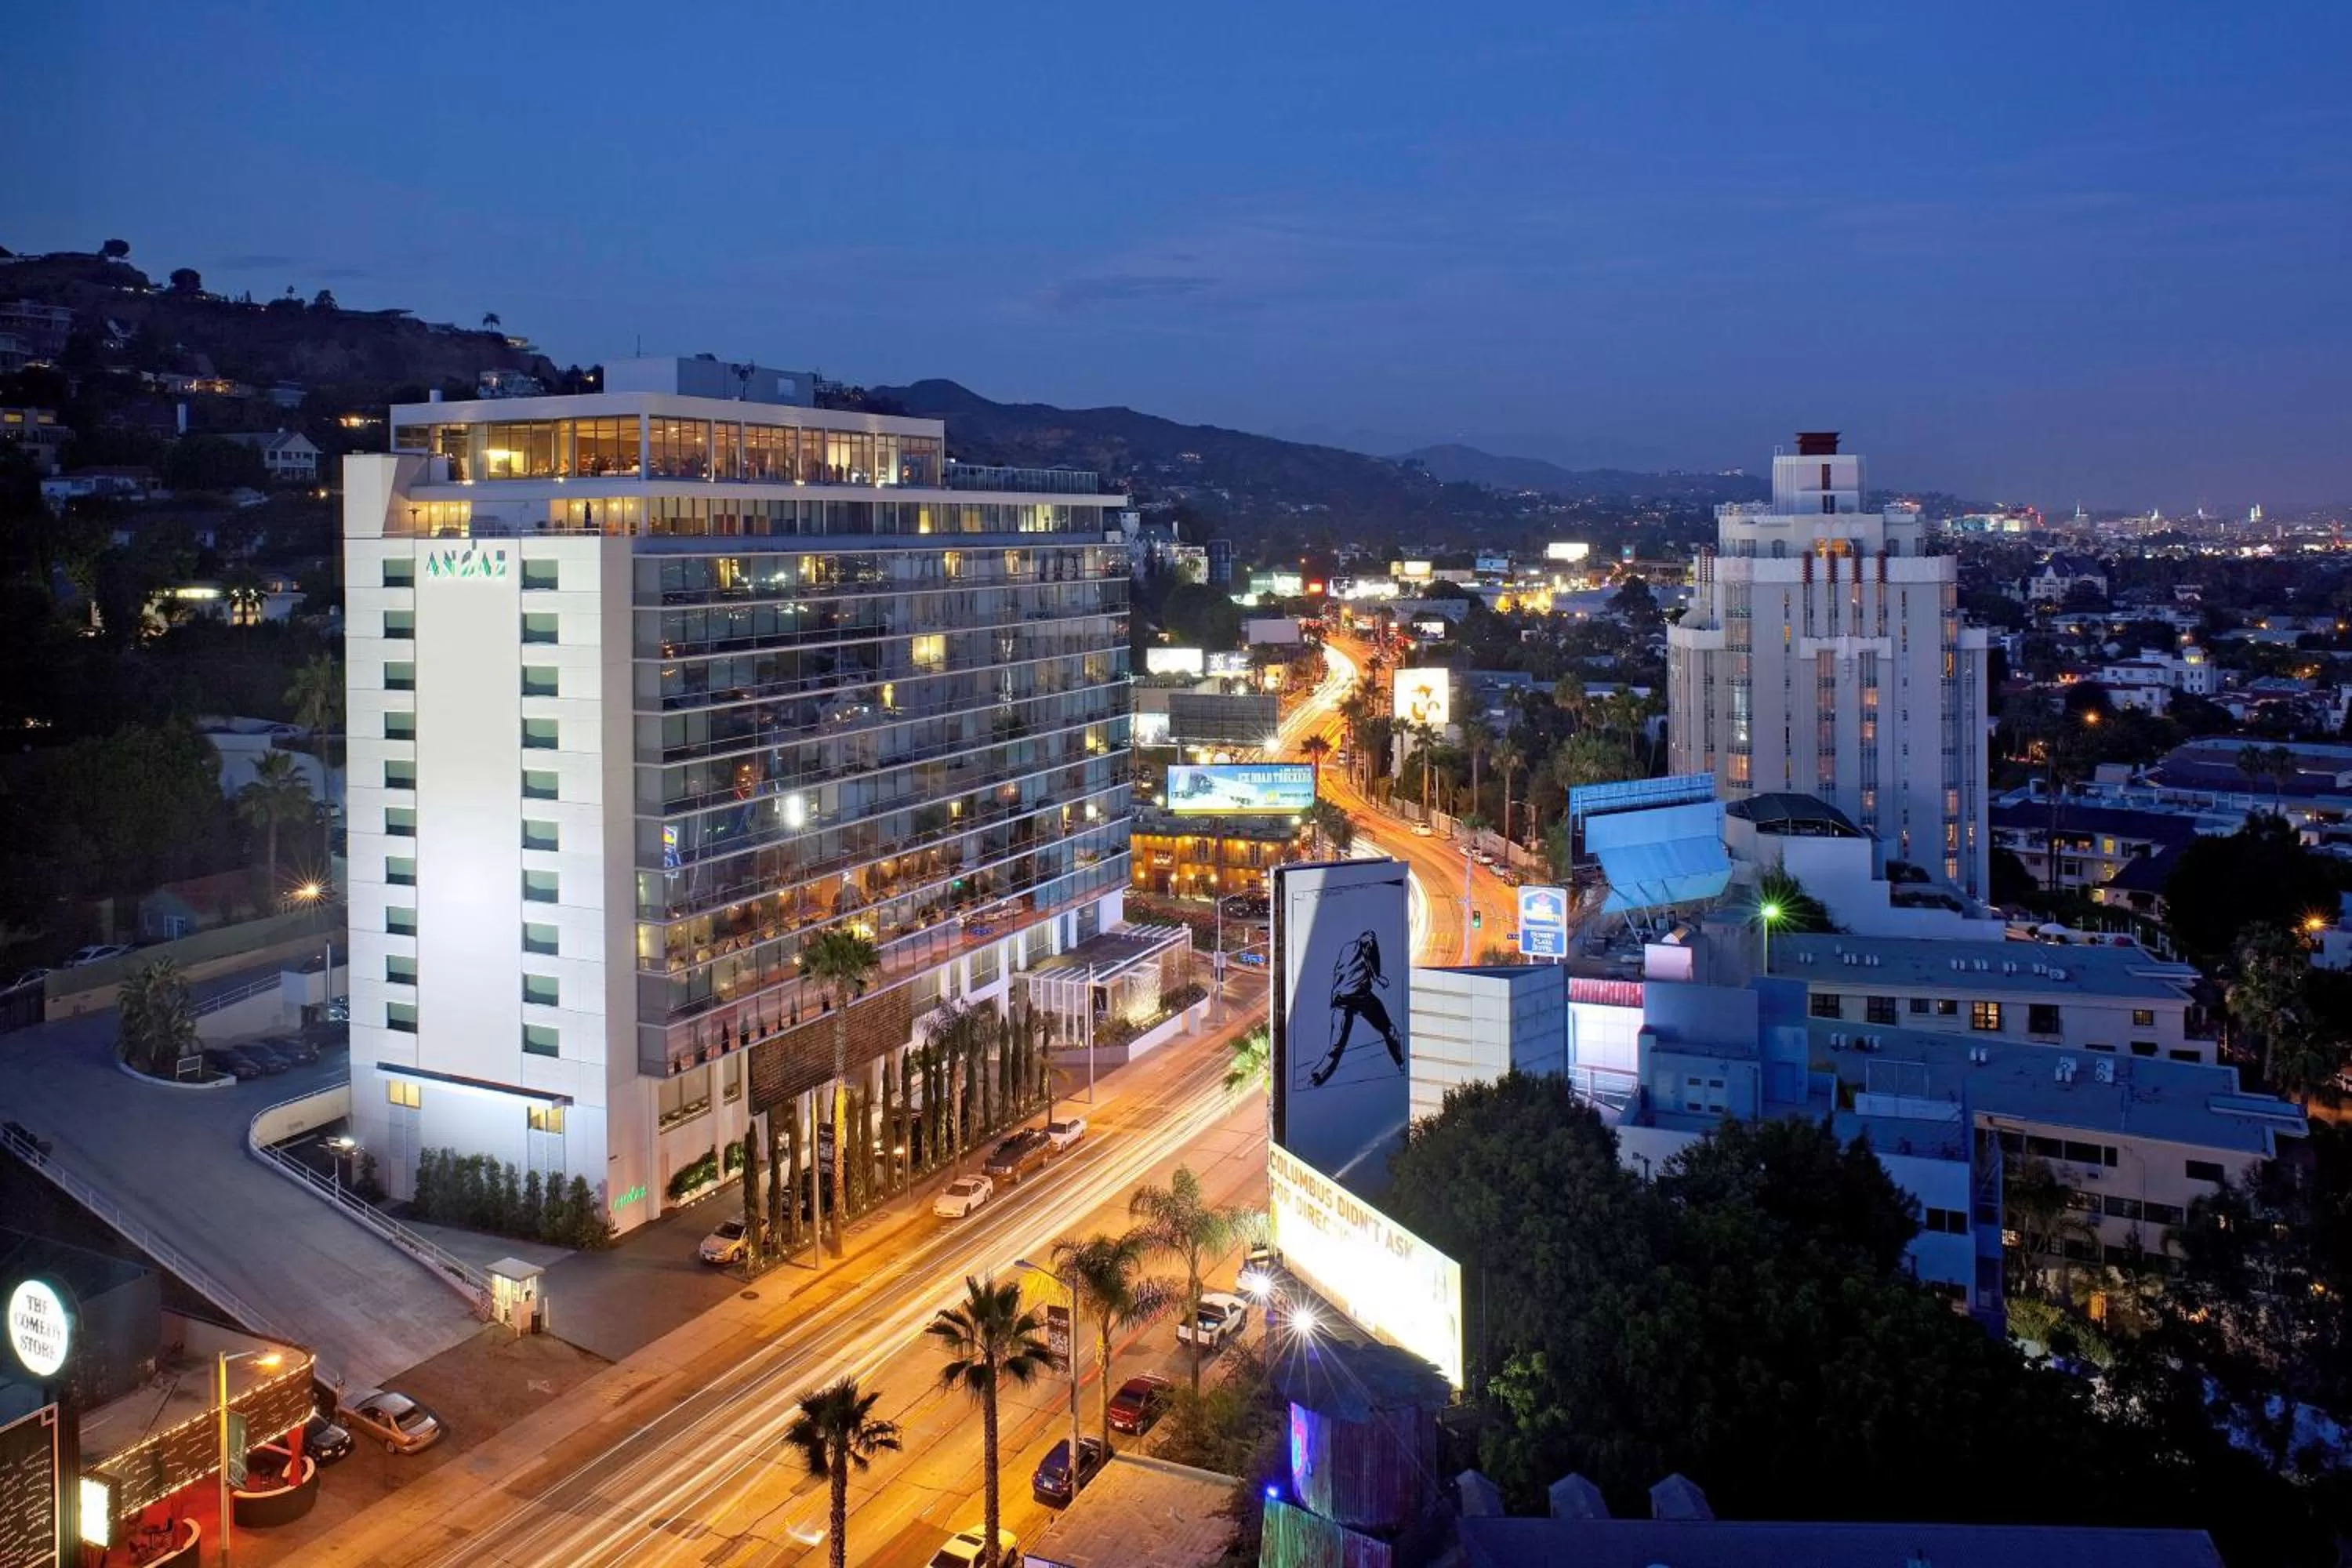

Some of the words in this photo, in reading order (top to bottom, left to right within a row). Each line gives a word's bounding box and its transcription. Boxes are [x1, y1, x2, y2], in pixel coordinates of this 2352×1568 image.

[1269, 1150, 1333, 1210] COLUMBUS
[1336, 1194, 1381, 1242] DIDN'T
[25, 1294, 49, 1315] THE
[14, 1311, 61, 1341] COMEDY
[20, 1334, 57, 1362] STORE
